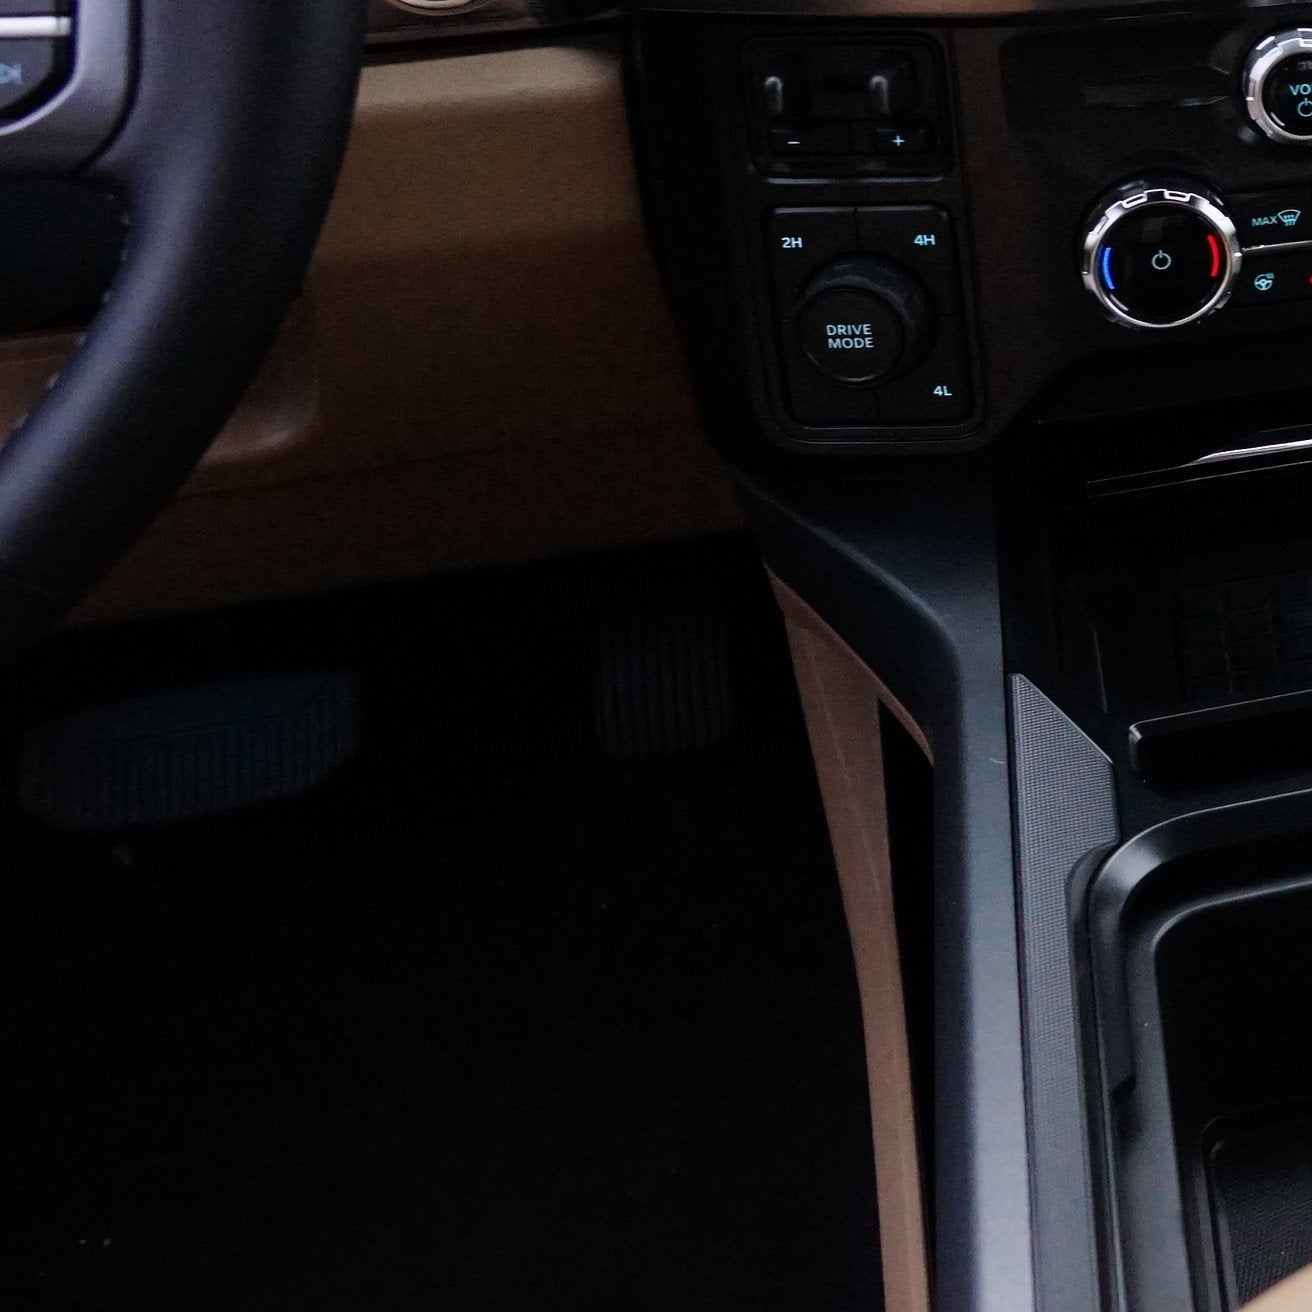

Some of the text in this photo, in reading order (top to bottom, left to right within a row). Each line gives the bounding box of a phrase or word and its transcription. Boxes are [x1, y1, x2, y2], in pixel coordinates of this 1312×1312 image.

[1251, 215, 1279, 228] MAX
[781, 236, 803, 249] 2H
[913, 233, 937, 247] 4H
[825, 322, 873, 336] DRIVE
[827, 336, 875, 350] MODE
[932, 384, 953, 397] 4L
